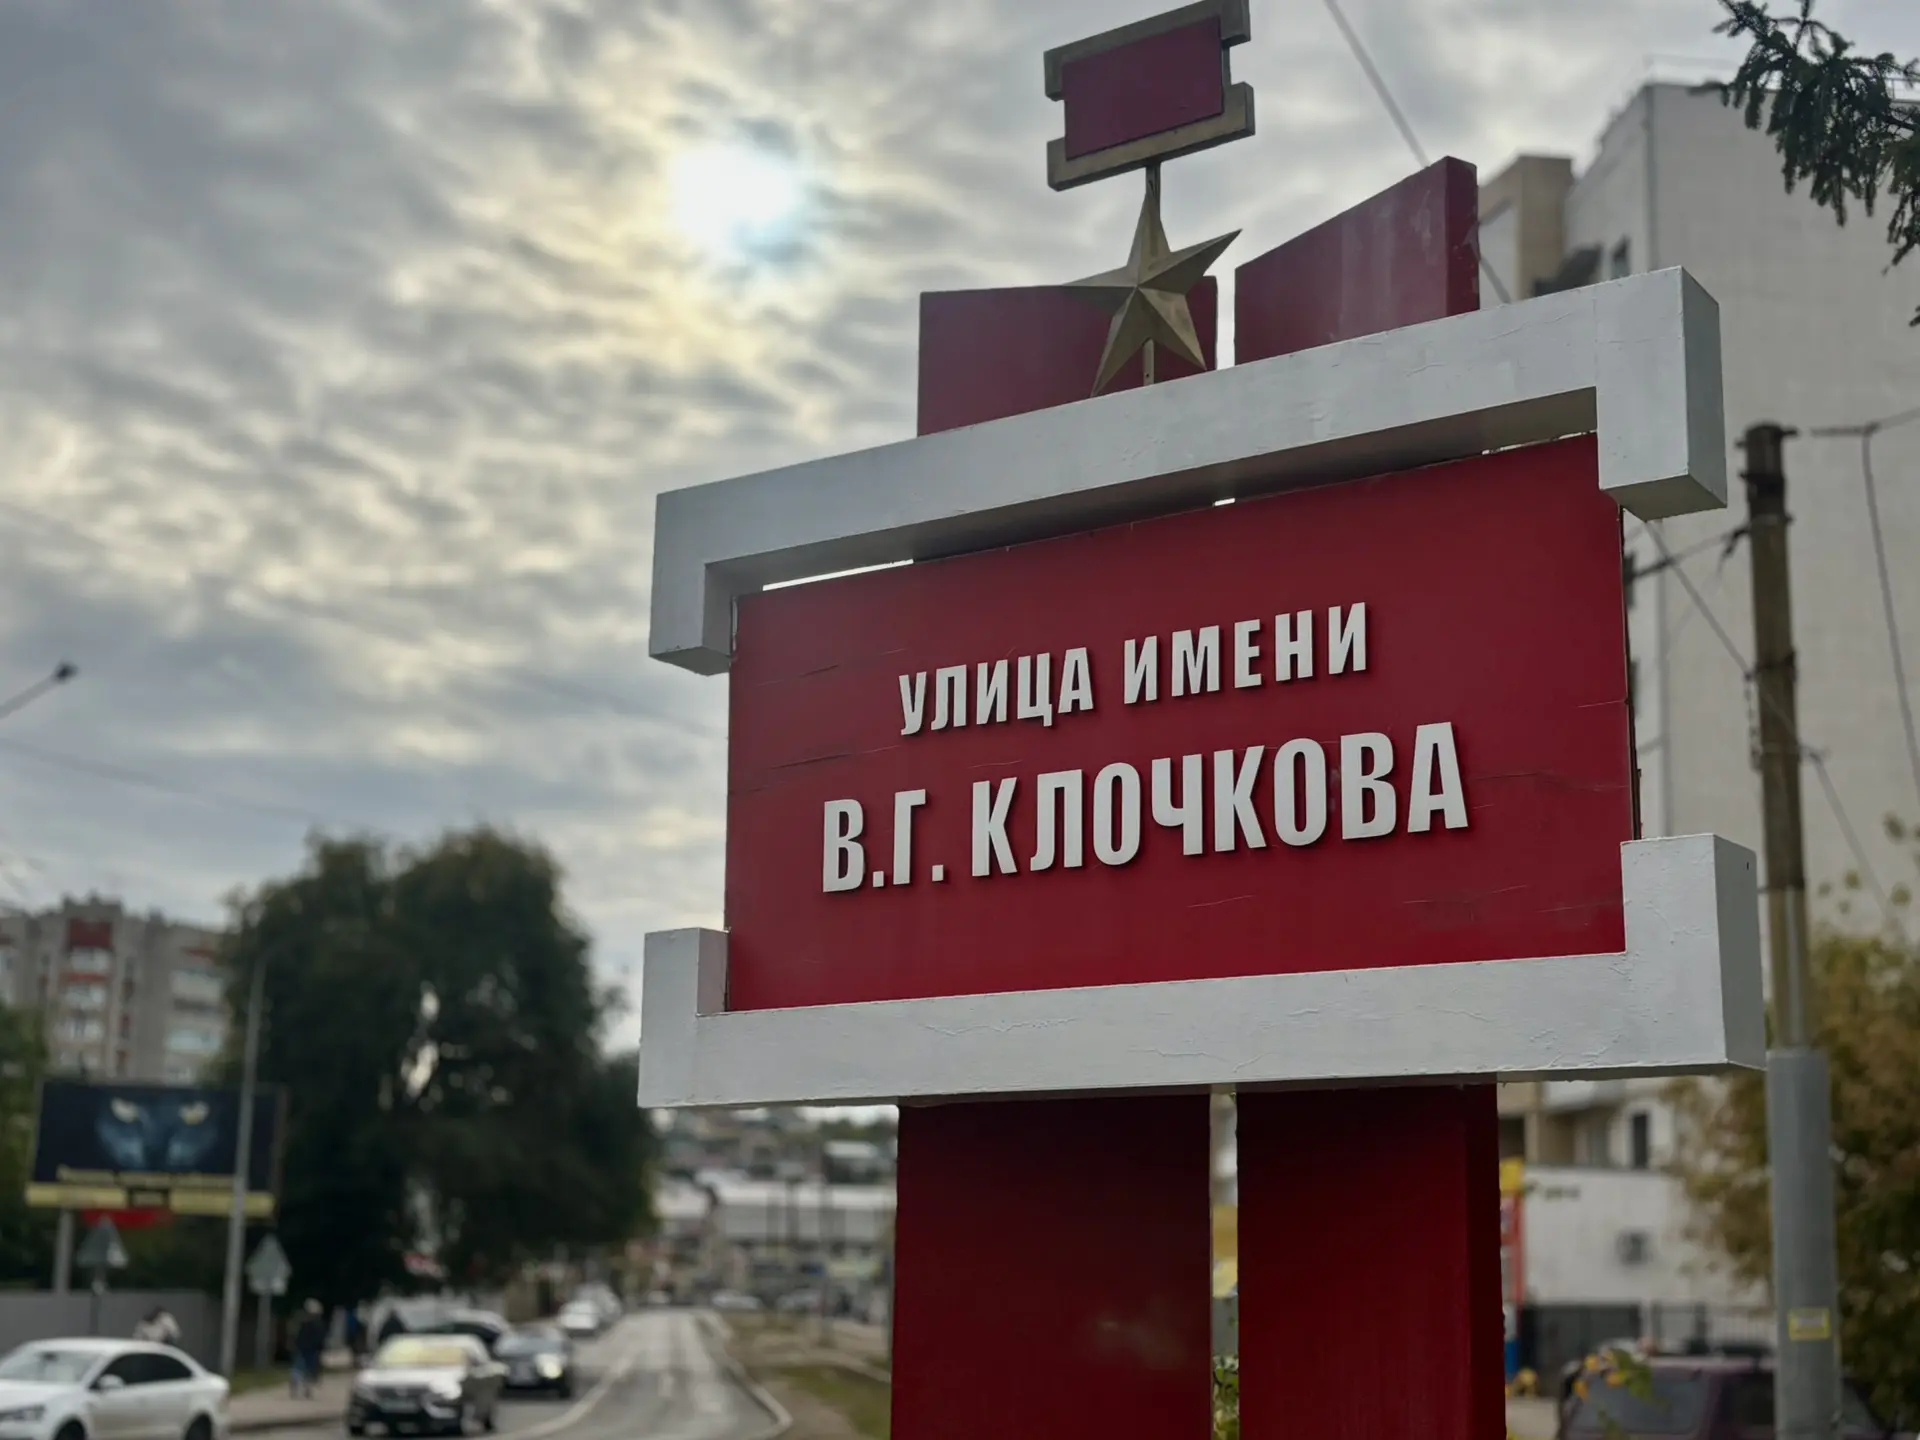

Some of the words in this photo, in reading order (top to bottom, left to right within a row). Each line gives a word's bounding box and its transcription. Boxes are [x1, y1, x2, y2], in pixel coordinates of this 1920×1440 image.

[899, 647, 1093, 735] УЛИЦА
[1124, 602, 1367, 704] ИМЕНИ
[822, 789, 944, 892] В.Г.
[971, 721, 1469, 877] КЛОЧКОВА
